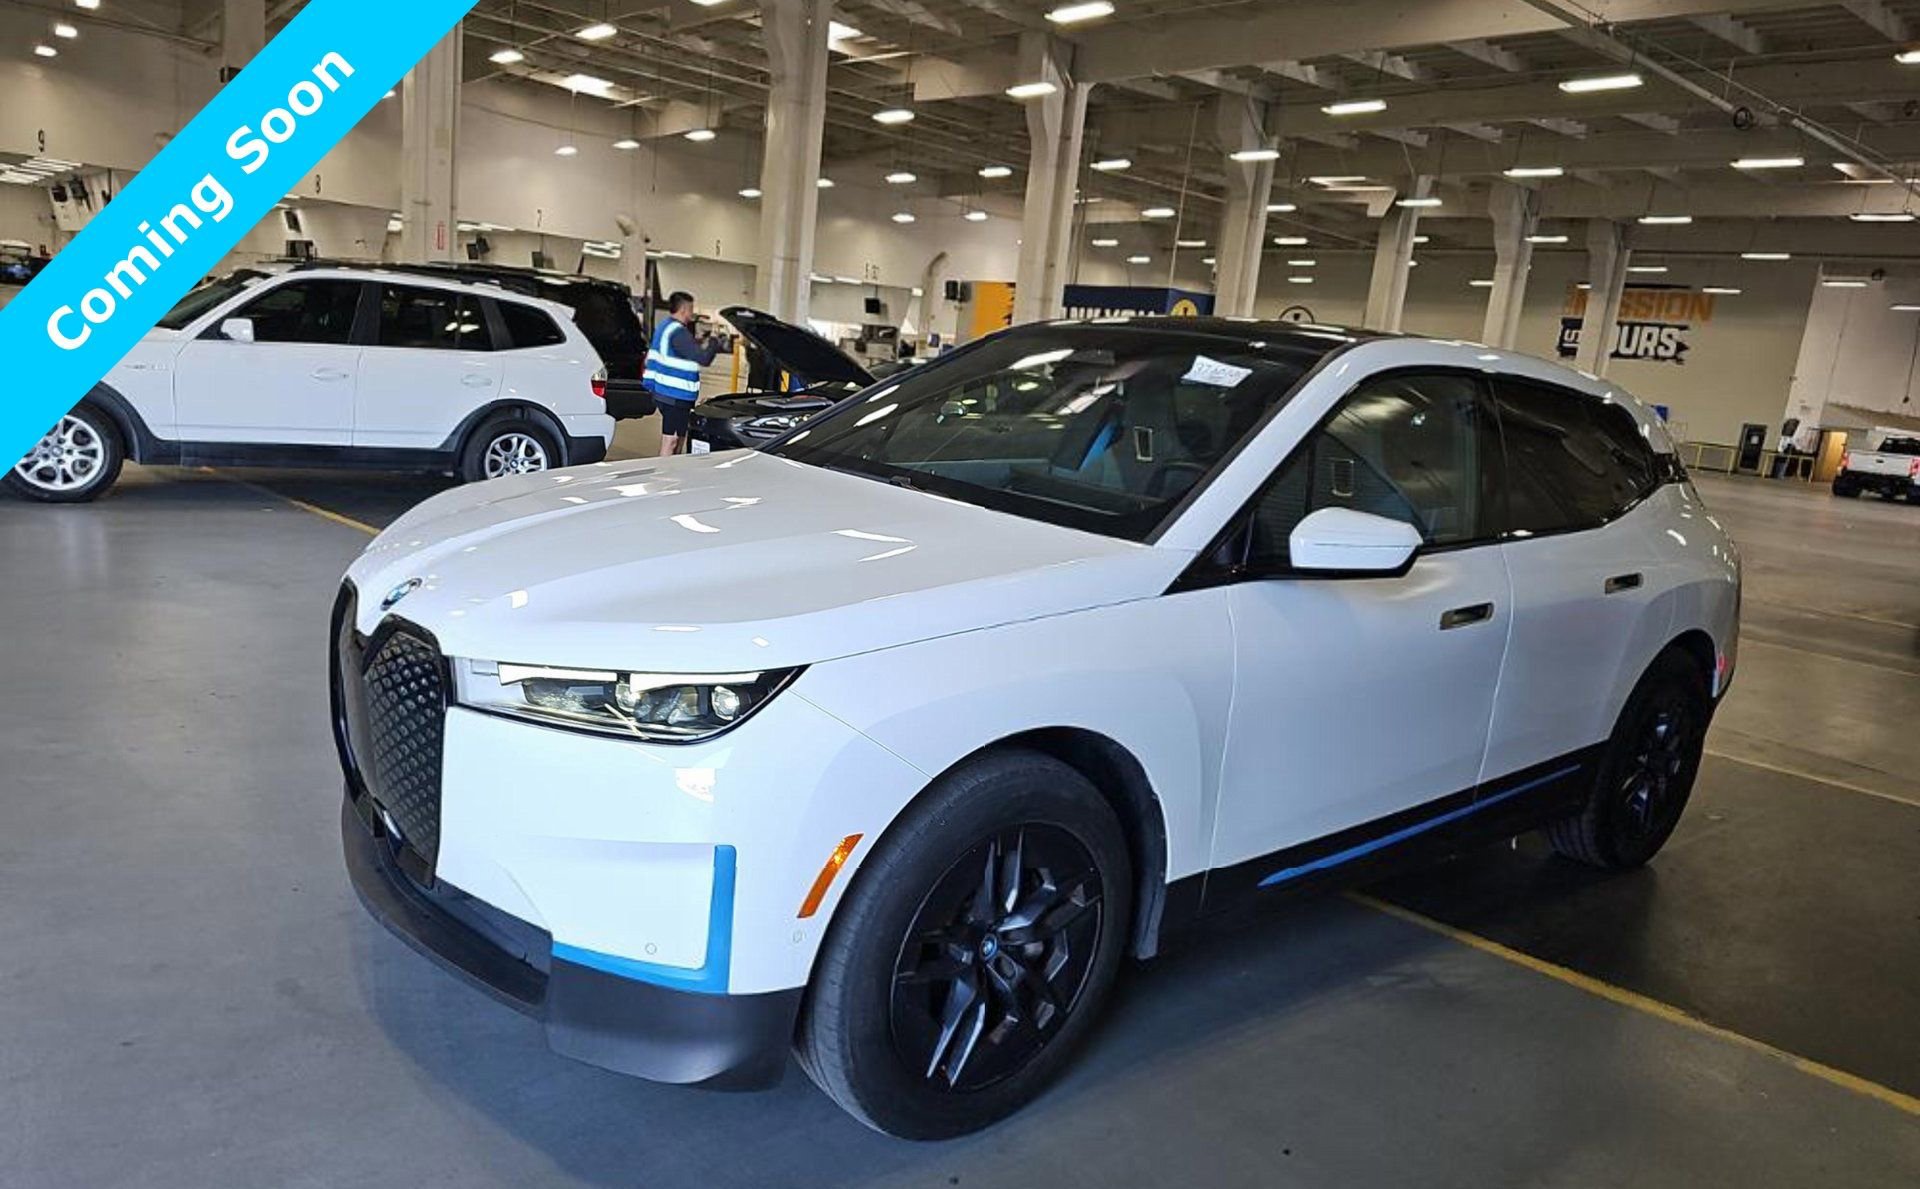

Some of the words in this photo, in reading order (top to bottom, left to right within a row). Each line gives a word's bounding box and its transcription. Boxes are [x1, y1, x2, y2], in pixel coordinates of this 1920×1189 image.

[38, 128, 45, 152] 9
[1565, 289, 1714, 321] MSSION
[1608, 326, 1679, 356] URS
